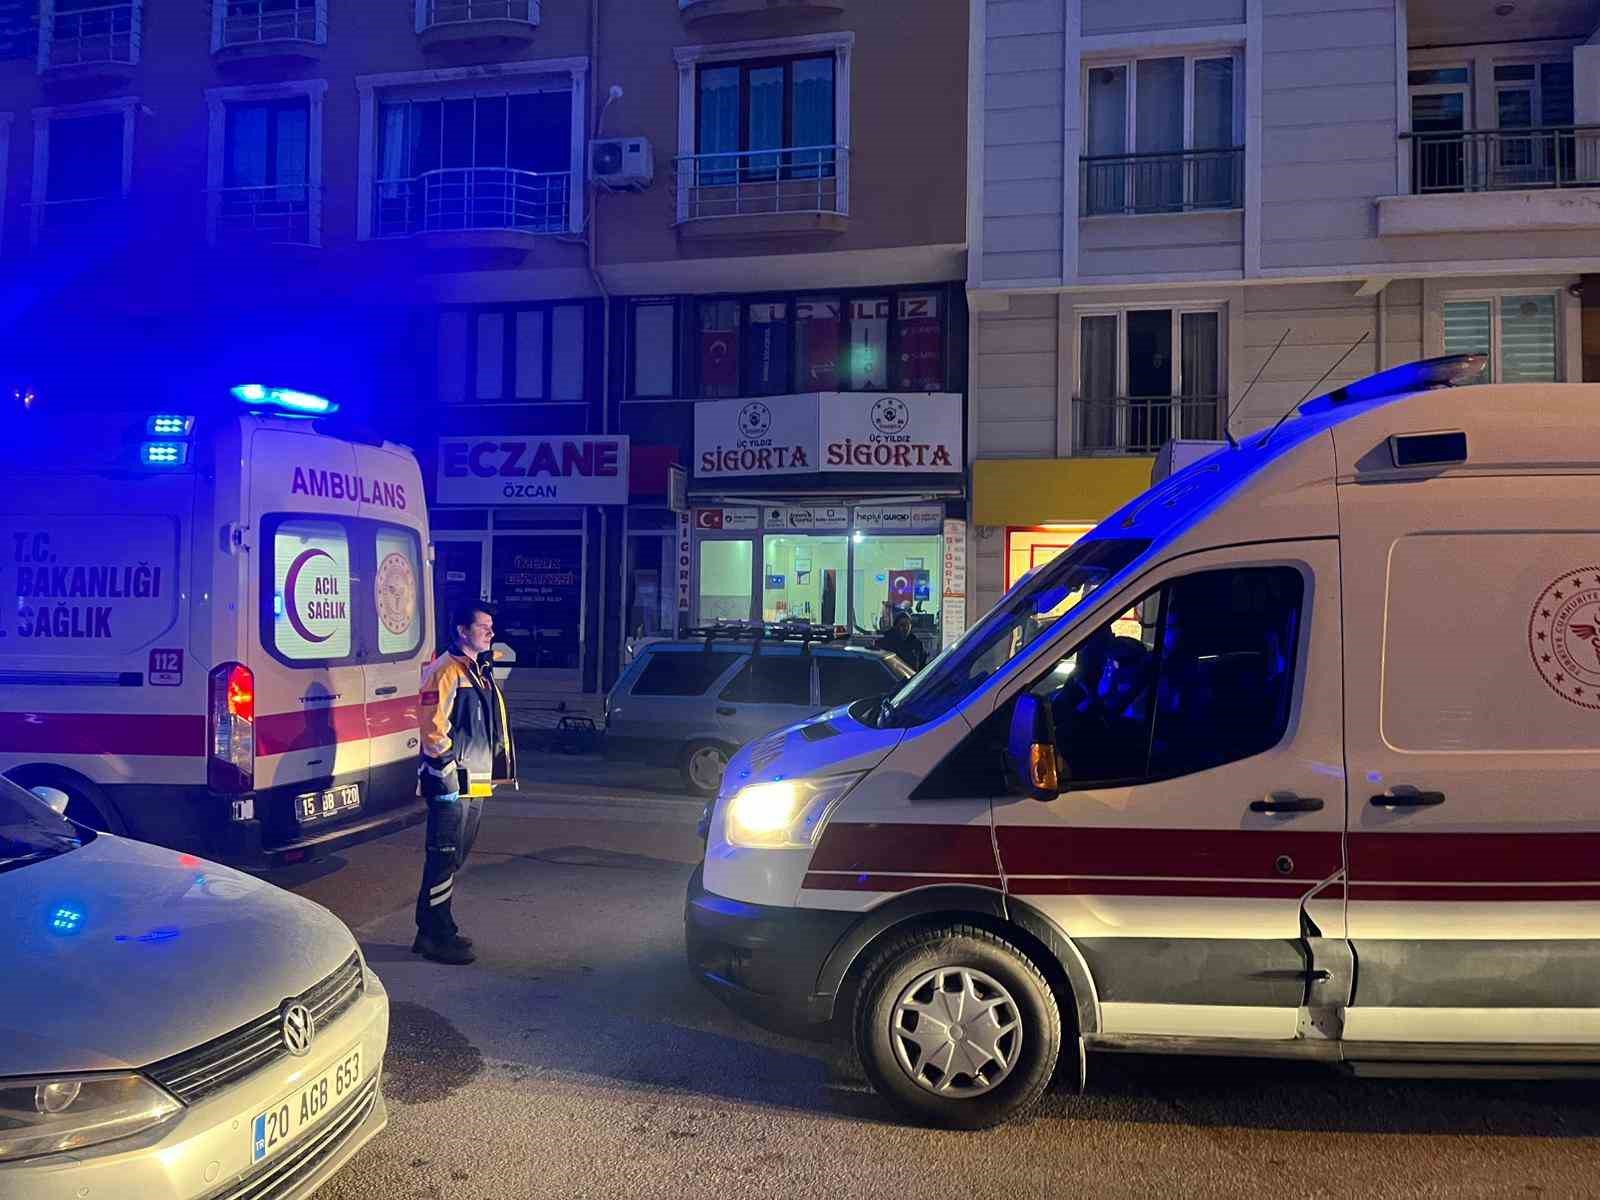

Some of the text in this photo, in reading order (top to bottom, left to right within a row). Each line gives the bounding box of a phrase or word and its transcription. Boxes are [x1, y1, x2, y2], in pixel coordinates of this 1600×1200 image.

[826, 438, 952, 467] SİGORTA
[883, 435, 910, 444] YILDIZ
[444, 441, 618, 478] ECZANE
[700, 446, 808, 473] SİGORTA
[291, 466, 406, 510] AMBULANS
[503, 482, 557, 498] ÖZCAN
[13, 531, 57, 563] T.C.
[16, 561, 161, 598] BAKANLIĞI
[315, 574, 339, 595] ACİL
[17, 601, 113, 638] SAĞLIK
[308, 598, 346, 619] SAĞLIK
[154, 653, 179, 671] 112
[302, 797, 315, 816] 15
[342, 787, 357, 806] 120
[267, 1103, 289, 1148] 20
[300, 1077, 328, 1126] AGB
[335, 1052, 359, 1097] 653
